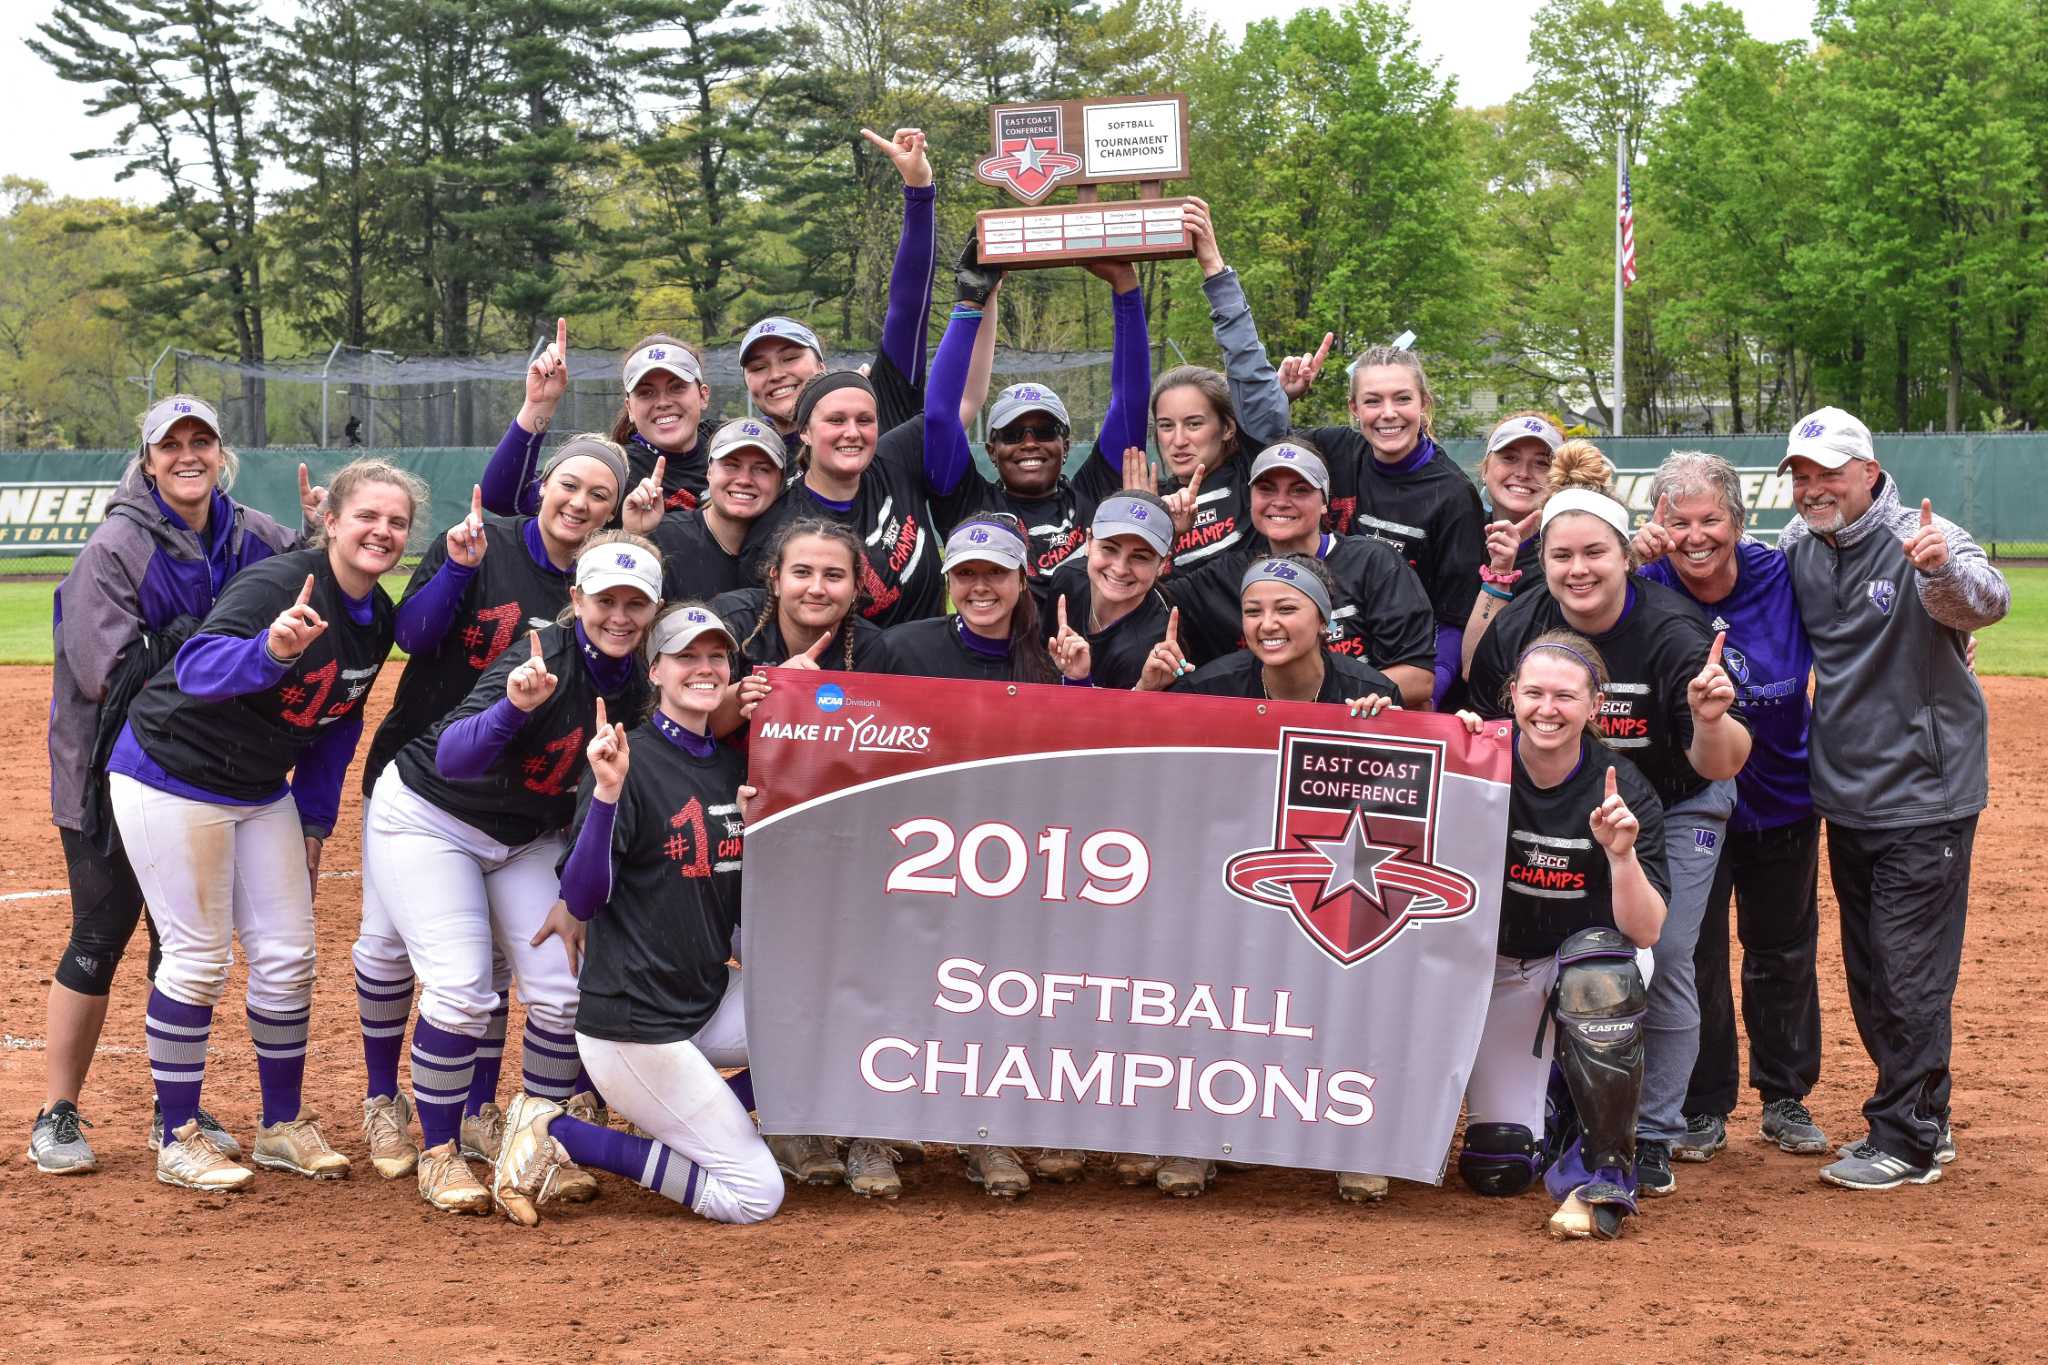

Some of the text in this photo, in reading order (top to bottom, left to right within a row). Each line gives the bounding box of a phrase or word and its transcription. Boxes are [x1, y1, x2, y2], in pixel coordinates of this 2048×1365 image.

[1005, 115, 1053, 126] EAST COAST
[1108, 120, 1155, 130] SOFTBALL
[1005, 126, 1054, 136] CONFERENCE
[1095, 135, 1168, 147] TOURNAMENT
[1100, 146, 1165, 158] CHAMPIONS
[1263, 562, 1299, 581] UB
[280, 658, 339, 728] #1
[816, 696, 843, 706] NCAA
[845, 698, 875, 708] Division
[760, 714, 932, 753] MAKE IT YOURS
[1601, 716, 1649, 737] AMPS
[1303, 755, 1421, 780] EAST COAST
[1300, 779, 1418, 805] CONFERENCE
[664, 796, 712, 878] #1
[1694, 829, 1717, 848] UB
[885, 817, 1152, 906] 2019
[1535, 854, 1568, 868] ECC
[1510, 864, 1585, 889] CHAMPS
[934, 957, 1314, 1040] SOFTBALL
[1589, 1022, 1635, 1033] EASTON
[858, 1037, 1377, 1126] CHAMPIONS
